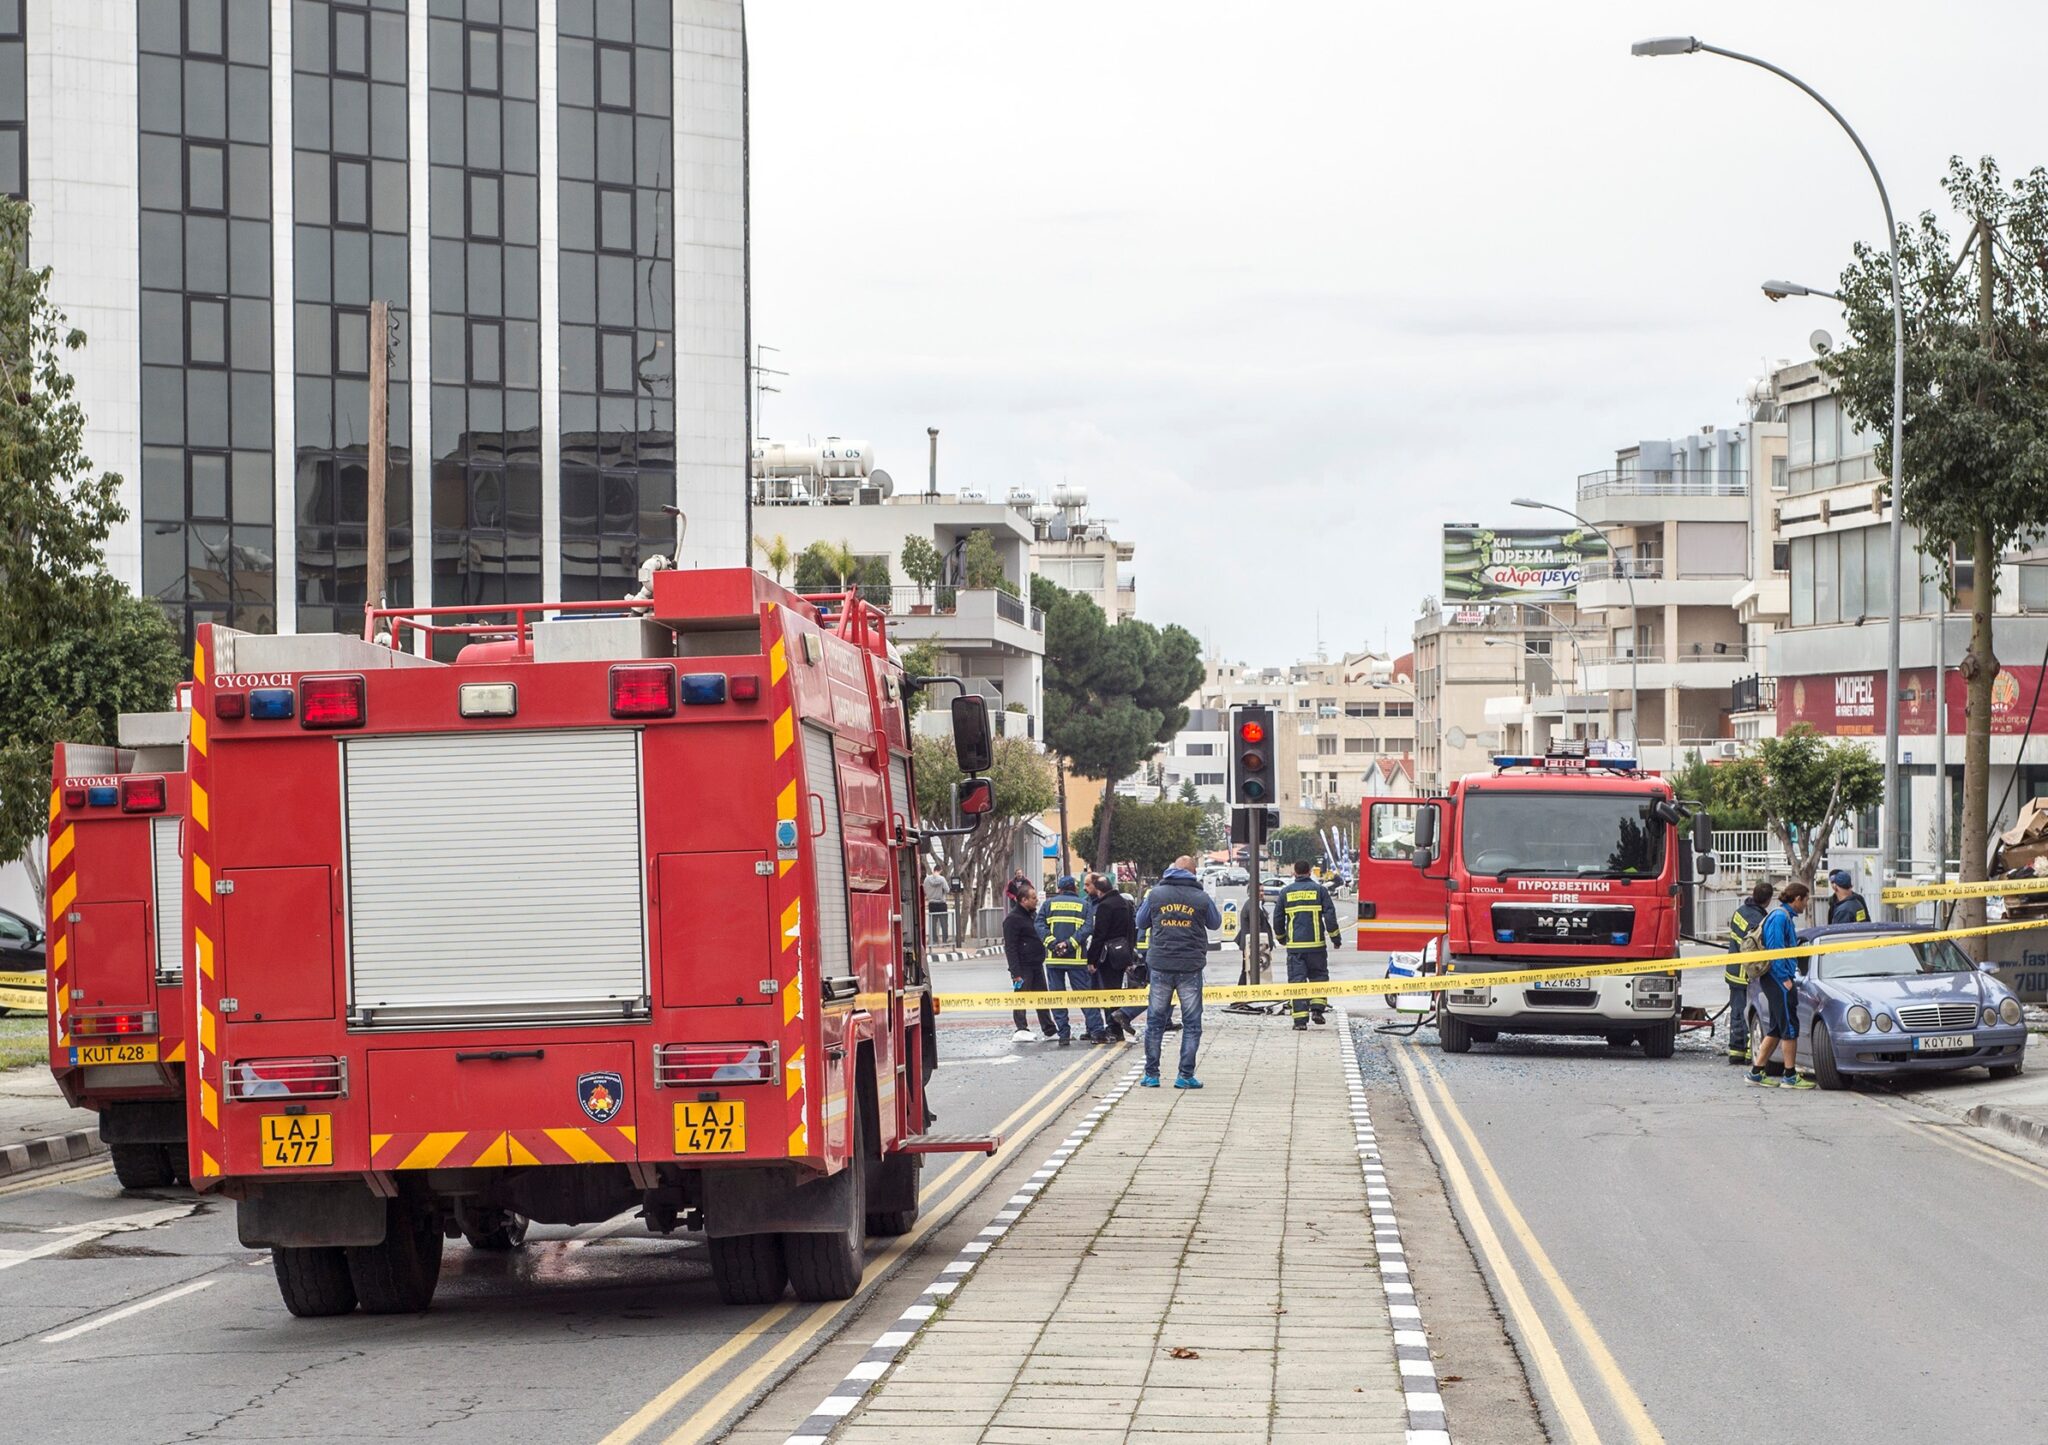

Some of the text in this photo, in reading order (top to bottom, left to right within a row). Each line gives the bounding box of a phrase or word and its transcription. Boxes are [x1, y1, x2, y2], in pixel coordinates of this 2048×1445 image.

[214, 673, 293, 689] CYCOACH
[1835, 675, 1875, 705] ΜΠΟΡΕΙΣ
[1546, 759, 1583, 768] FIRE
[65, 776, 118, 788] CYCOACH
[1471, 886, 1504, 894] CYCOACH
[1517, 880, 1611, 892] ΠΥΡΟΣΒΕΣΤΙΚΗ
[1551, 893, 1579, 903] FIRE
[1160, 903, 1195, 916] POWER
[1160, 919, 1192, 928] GARAGE
[1537, 916, 1589, 928] MAN
[83, 1047, 114, 1062] KUT
[118, 1046, 144, 1061] 428
[685, 1105, 734, 1128] LAJ
[271, 1118, 320, 1141] LAJ
[688, 1128, 732, 1150] 477
[276, 1141, 318, 1163] 477
